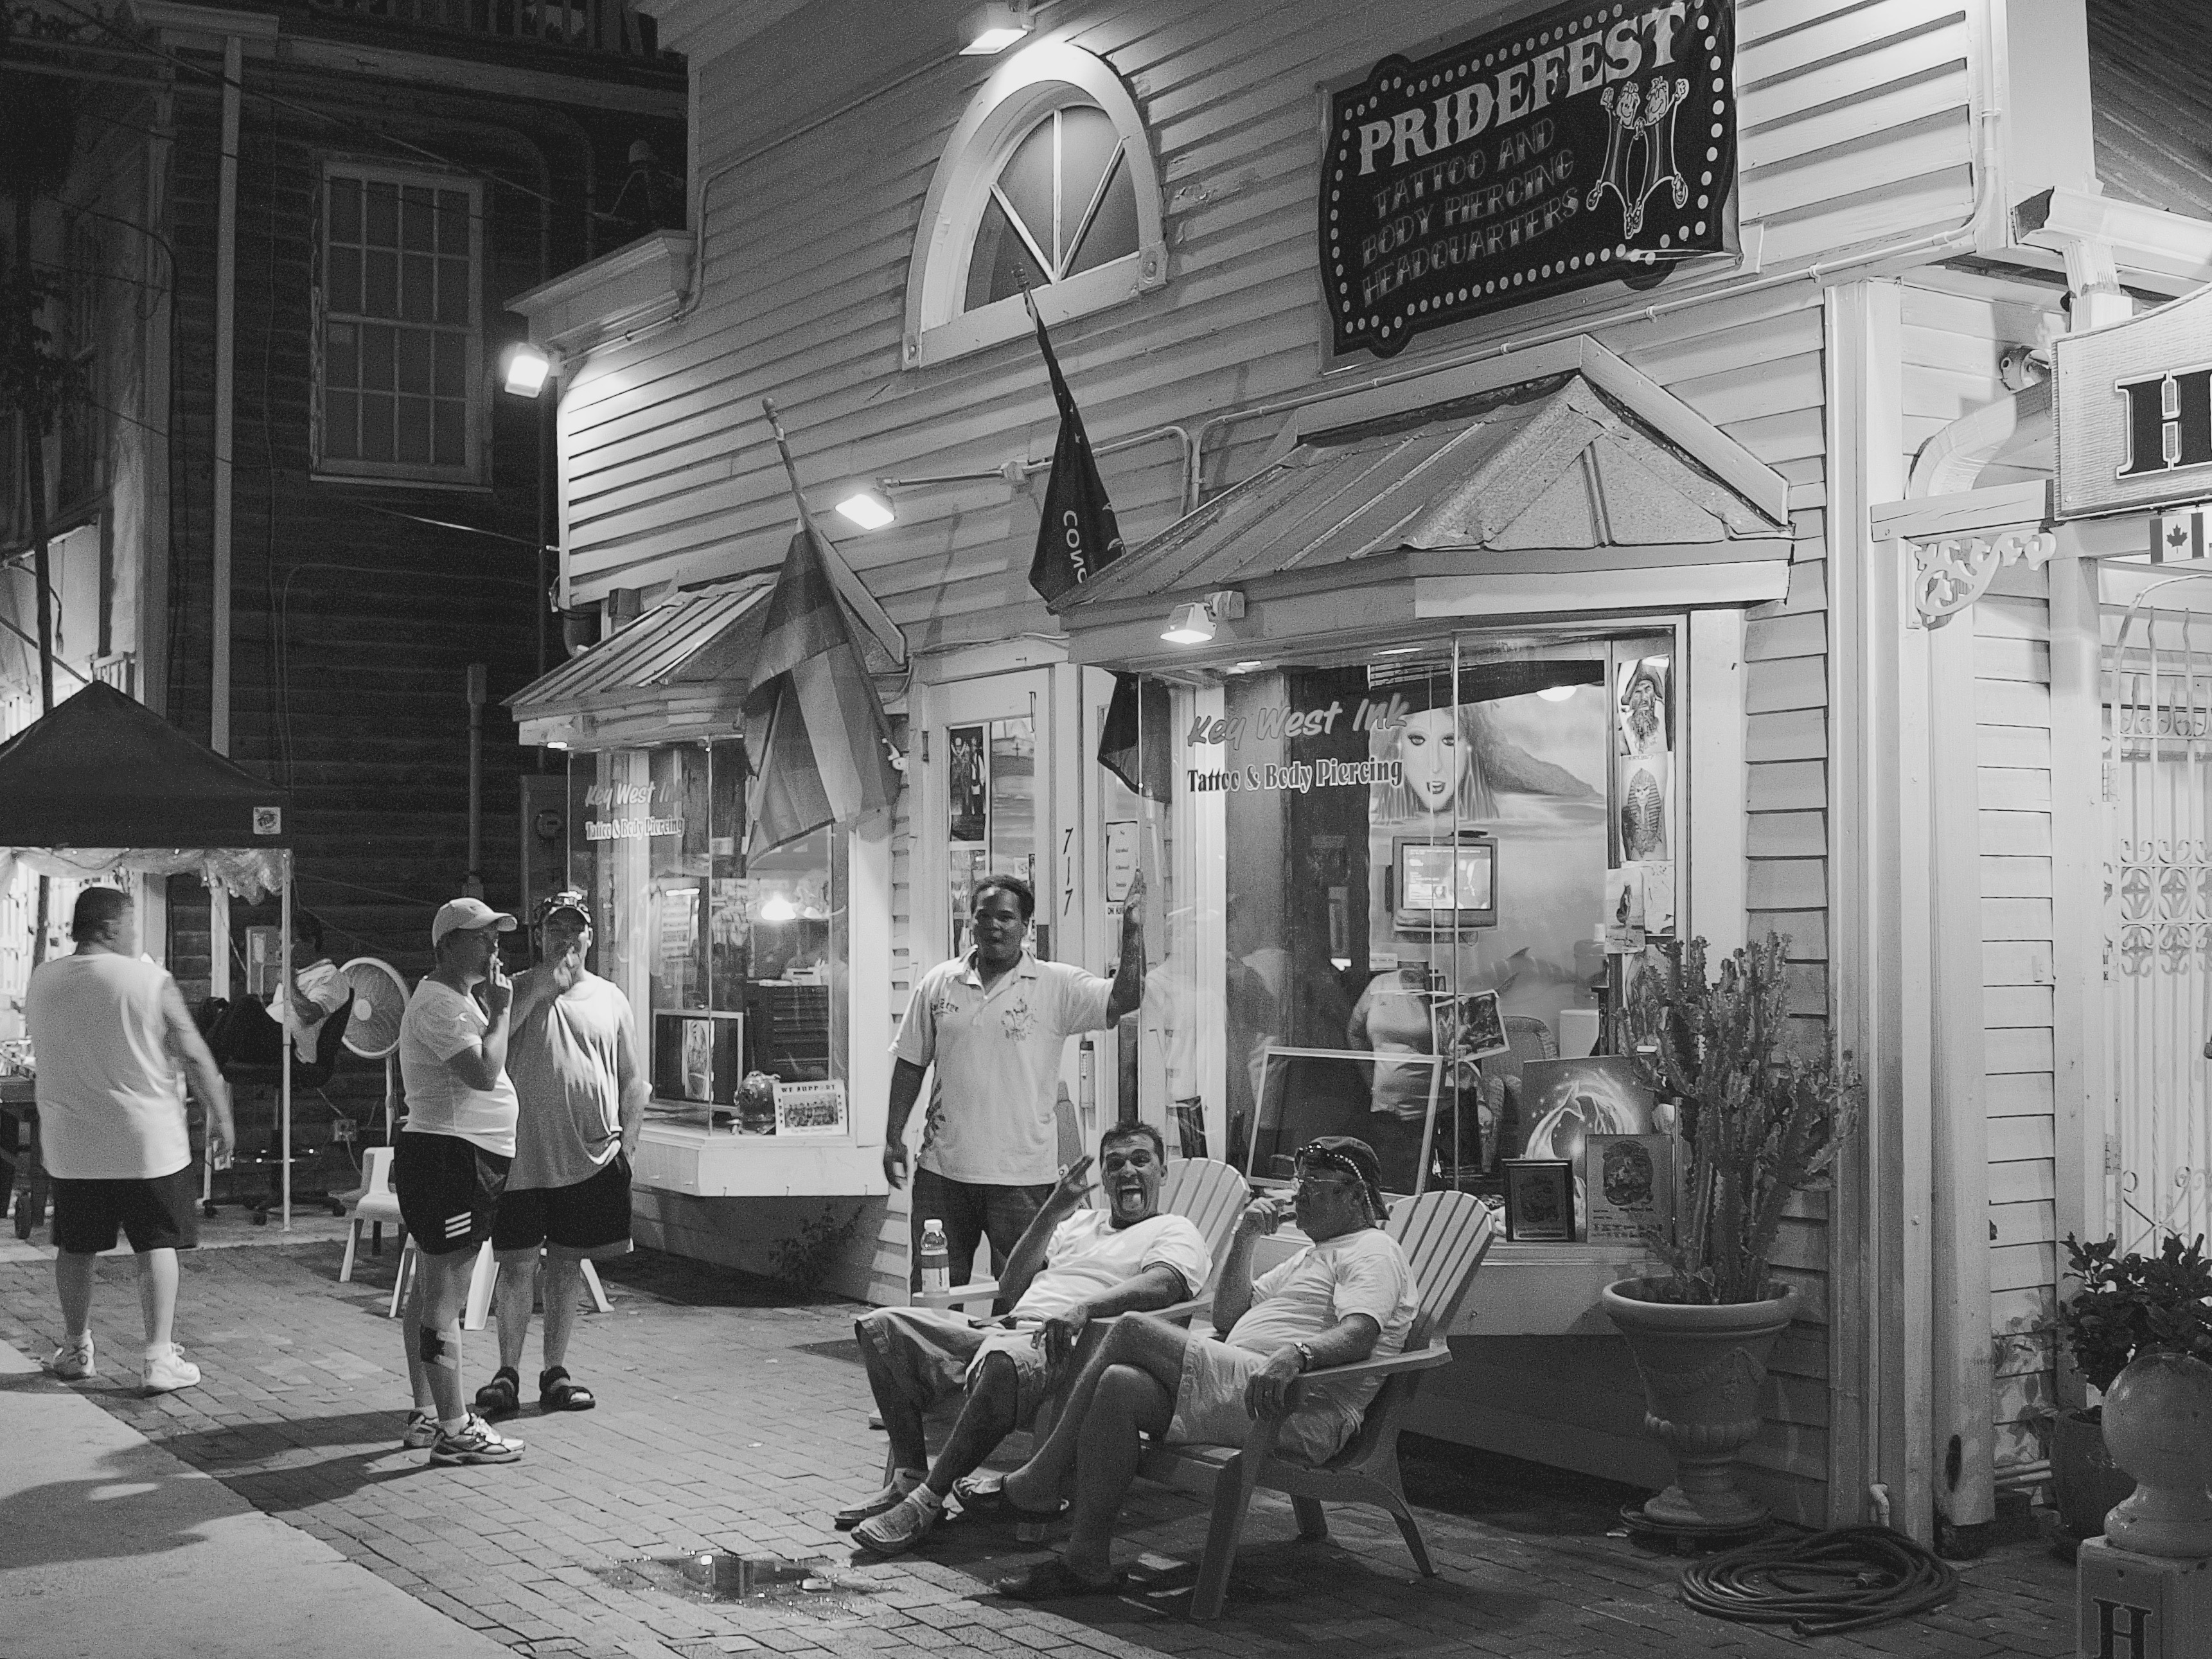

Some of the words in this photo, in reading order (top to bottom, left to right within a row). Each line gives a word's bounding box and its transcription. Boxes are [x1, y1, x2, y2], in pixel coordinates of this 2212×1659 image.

[1358, 1, 1686, 176] PRIDEFEST
[1362, 204, 1434, 268] BODY
[1445, 149, 1574, 226] PIERCING
[1374, 149, 1487, 219] TATTOO
[1497, 118, 1555, 172] AND
[1362, 187, 1579, 307] HEADQUARTERS
[1188, 716, 1247, 750] Key
[1257, 701, 1343, 740] West
[1352, 693, 1410, 731] Ink
[585, 785, 614, 811] Key
[616, 781, 656, 804] West
[1188, 768, 1241, 792] Tattoo
[1244, 765, 1261, 791] &
[1264, 761, 1313, 794] Body
[1316, 757, 1404, 788] Piercing
[1063, 827, 1074, 916] 717
